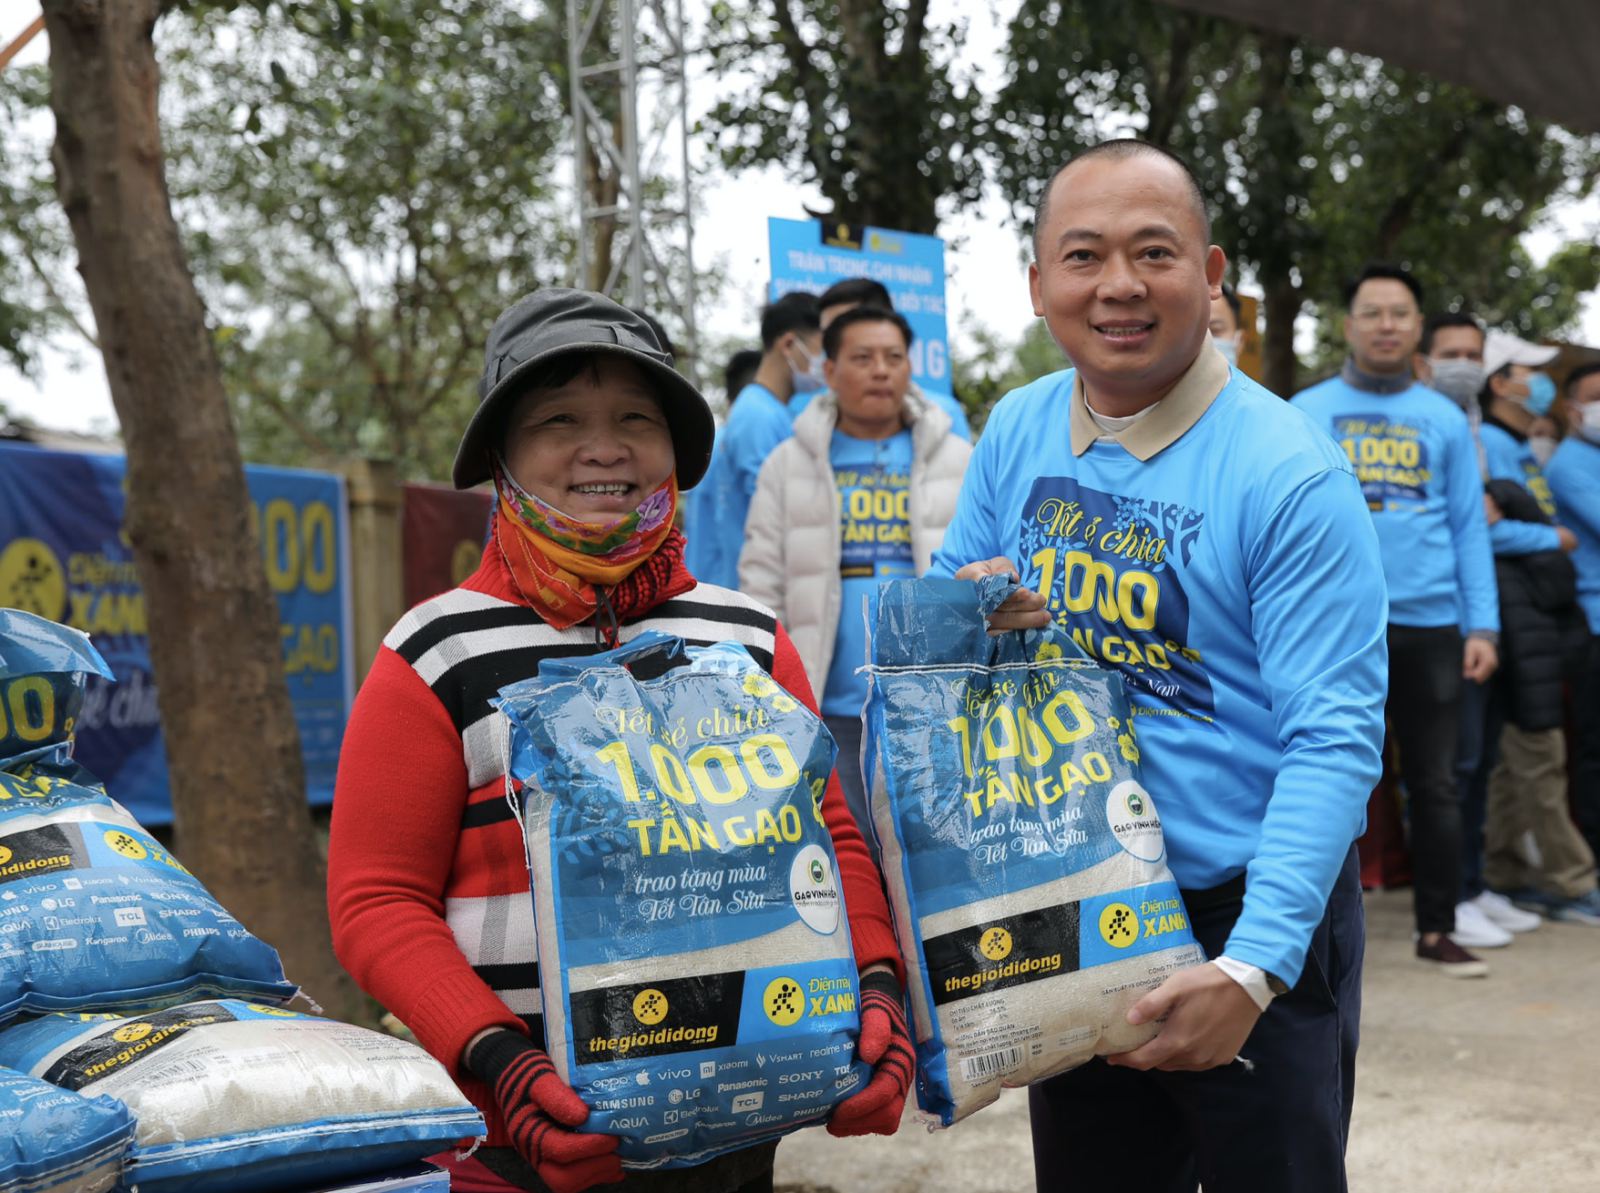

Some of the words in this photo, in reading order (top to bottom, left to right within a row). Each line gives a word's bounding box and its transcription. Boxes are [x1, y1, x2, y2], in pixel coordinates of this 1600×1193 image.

[1100, 522, 1166, 563] chia
[595, 705, 656, 736] Tết
[697, 704, 769, 738] chia
[594, 733, 800, 805] 1.000
[964, 765, 1035, 818] TẤN
[1034, 751, 1112, 805] GẠO
[627, 801, 720, 856] TẤN
[722, 804, 802, 853] GẠO
[971, 823, 1005, 844] trao
[1044, 807, 1083, 832] mùa
[975, 843, 1008, 866] Tết
[1011, 837, 1050, 857] Tân
[23, 883, 57, 894] vivo
[635, 874, 676, 894] trao
[680, 868, 723, 892] tặng
[728, 861, 766, 882] mùa
[58, 897, 76, 907] LG
[90, 893, 142, 904] Panasonic
[150, 892, 190, 901] SONY
[638, 896, 674, 922] Tết
[679, 892, 722, 917] Tân
[727, 889, 766, 915] Sửu
[1140, 899, 1165, 915] Điện
[60, 916, 102, 926] Electrolux
[119, 912, 141, 921] TCL
[159, 909, 201, 918] SHARP
[1143, 912, 1187, 938] XANH
[85, 936, 128, 946] Kangaroo
[144, 931, 173, 941] Midea
[183, 927, 220, 938] PHILIPS
[808, 976, 835, 994] Điện
[945, 953, 1061, 992] thegioididong
[807, 992, 856, 1018] XANH
[84, 1016, 215, 1076] thegioididong
[589, 1024, 718, 1053] thegioididong
[592, 1076, 629, 1089] oppo
[657, 1069, 691, 1081] vivo
[718, 1060, 749, 1072] xiaomi
[810, 1045, 840, 1058] realme
[595, 1095, 655, 1110] SAMSUNG
[685, 1089, 701, 1100] LG
[717, 1078, 768, 1093] Panasonic
[779, 1070, 824, 1084] SONY
[680, 1105, 719, 1119] Electrolux
[737, 1098, 759, 1107] TCL
[778, 1090, 824, 1102] SHARP
[835, 1073, 859, 1090] beko
[752, 1113, 783, 1125] Midea
[793, 1103, 832, 1118] PHILIPS
